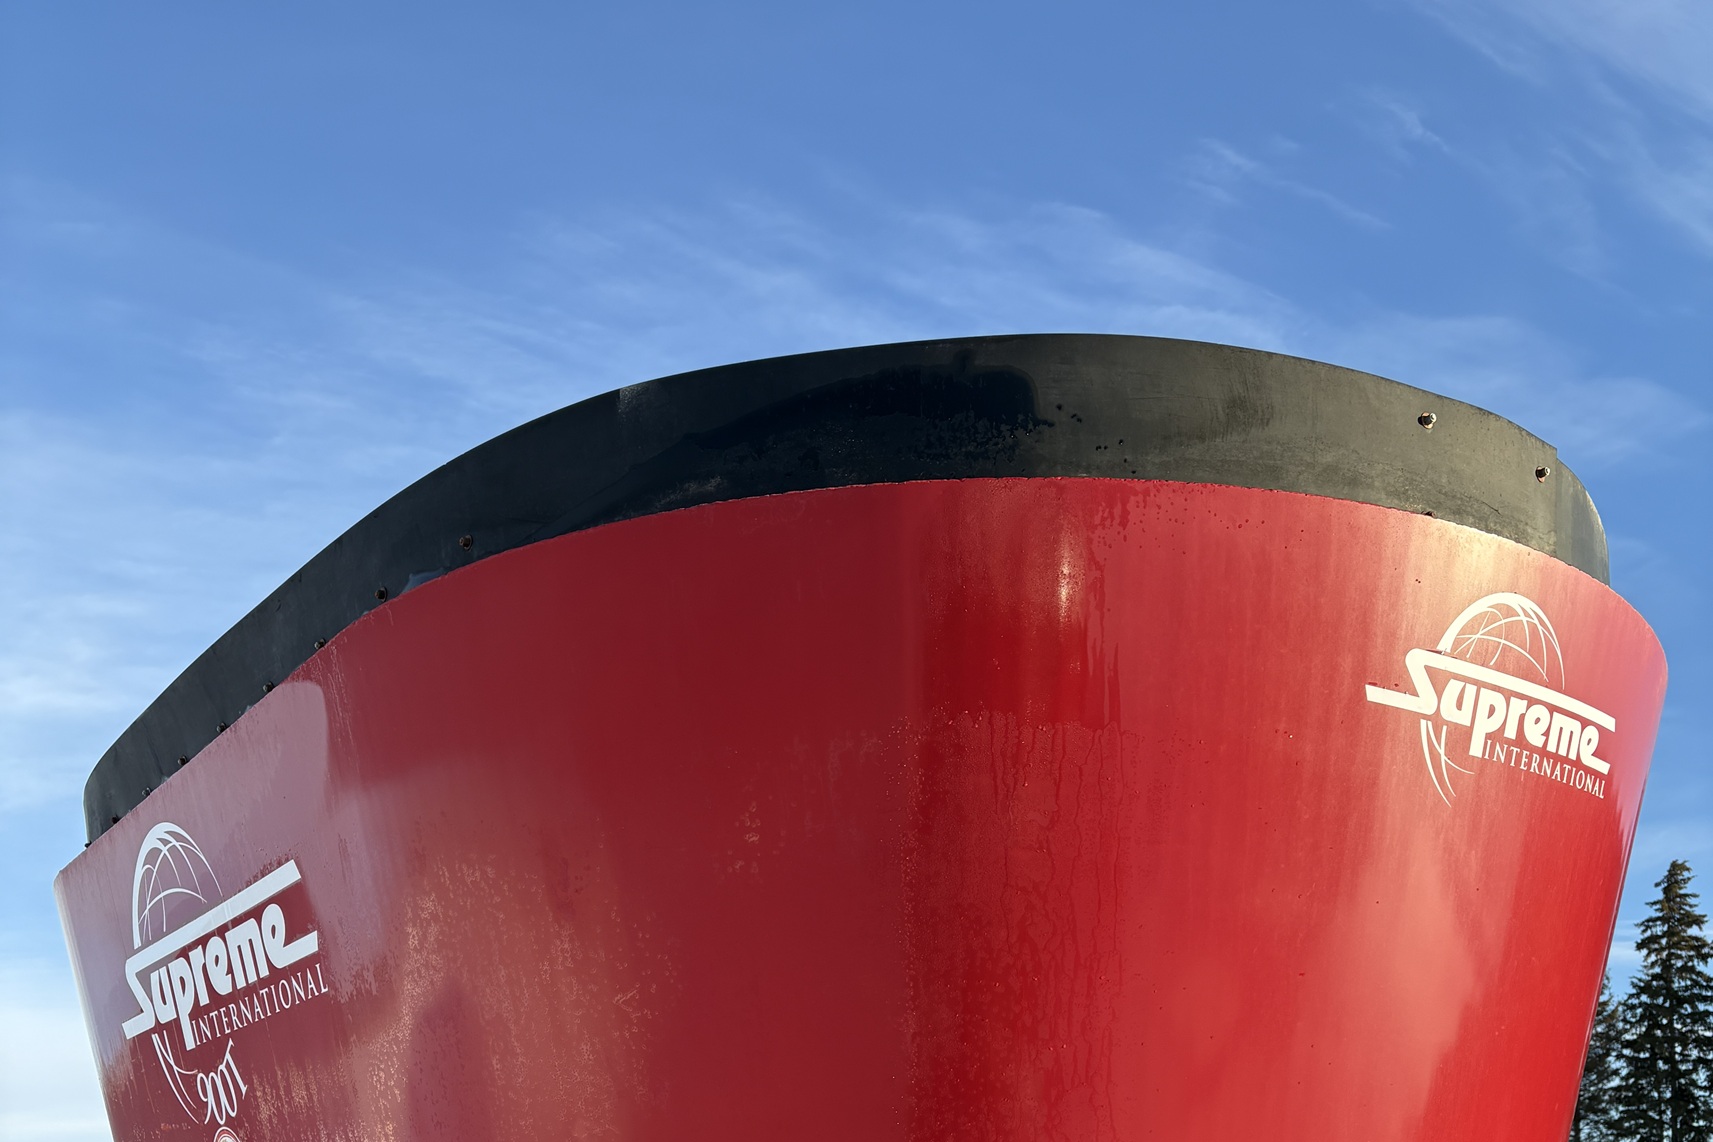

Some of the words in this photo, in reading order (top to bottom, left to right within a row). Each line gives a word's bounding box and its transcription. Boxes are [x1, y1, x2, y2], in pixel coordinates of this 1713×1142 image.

[1365, 648, 1616, 775] Supreme
[1483, 740, 1605, 799] INTERNATIONAL
[122, 860, 319, 1051] Supreme
[191, 963, 329, 1047] INTERNATIONAL
[197, 1037, 248, 1125] 900T
